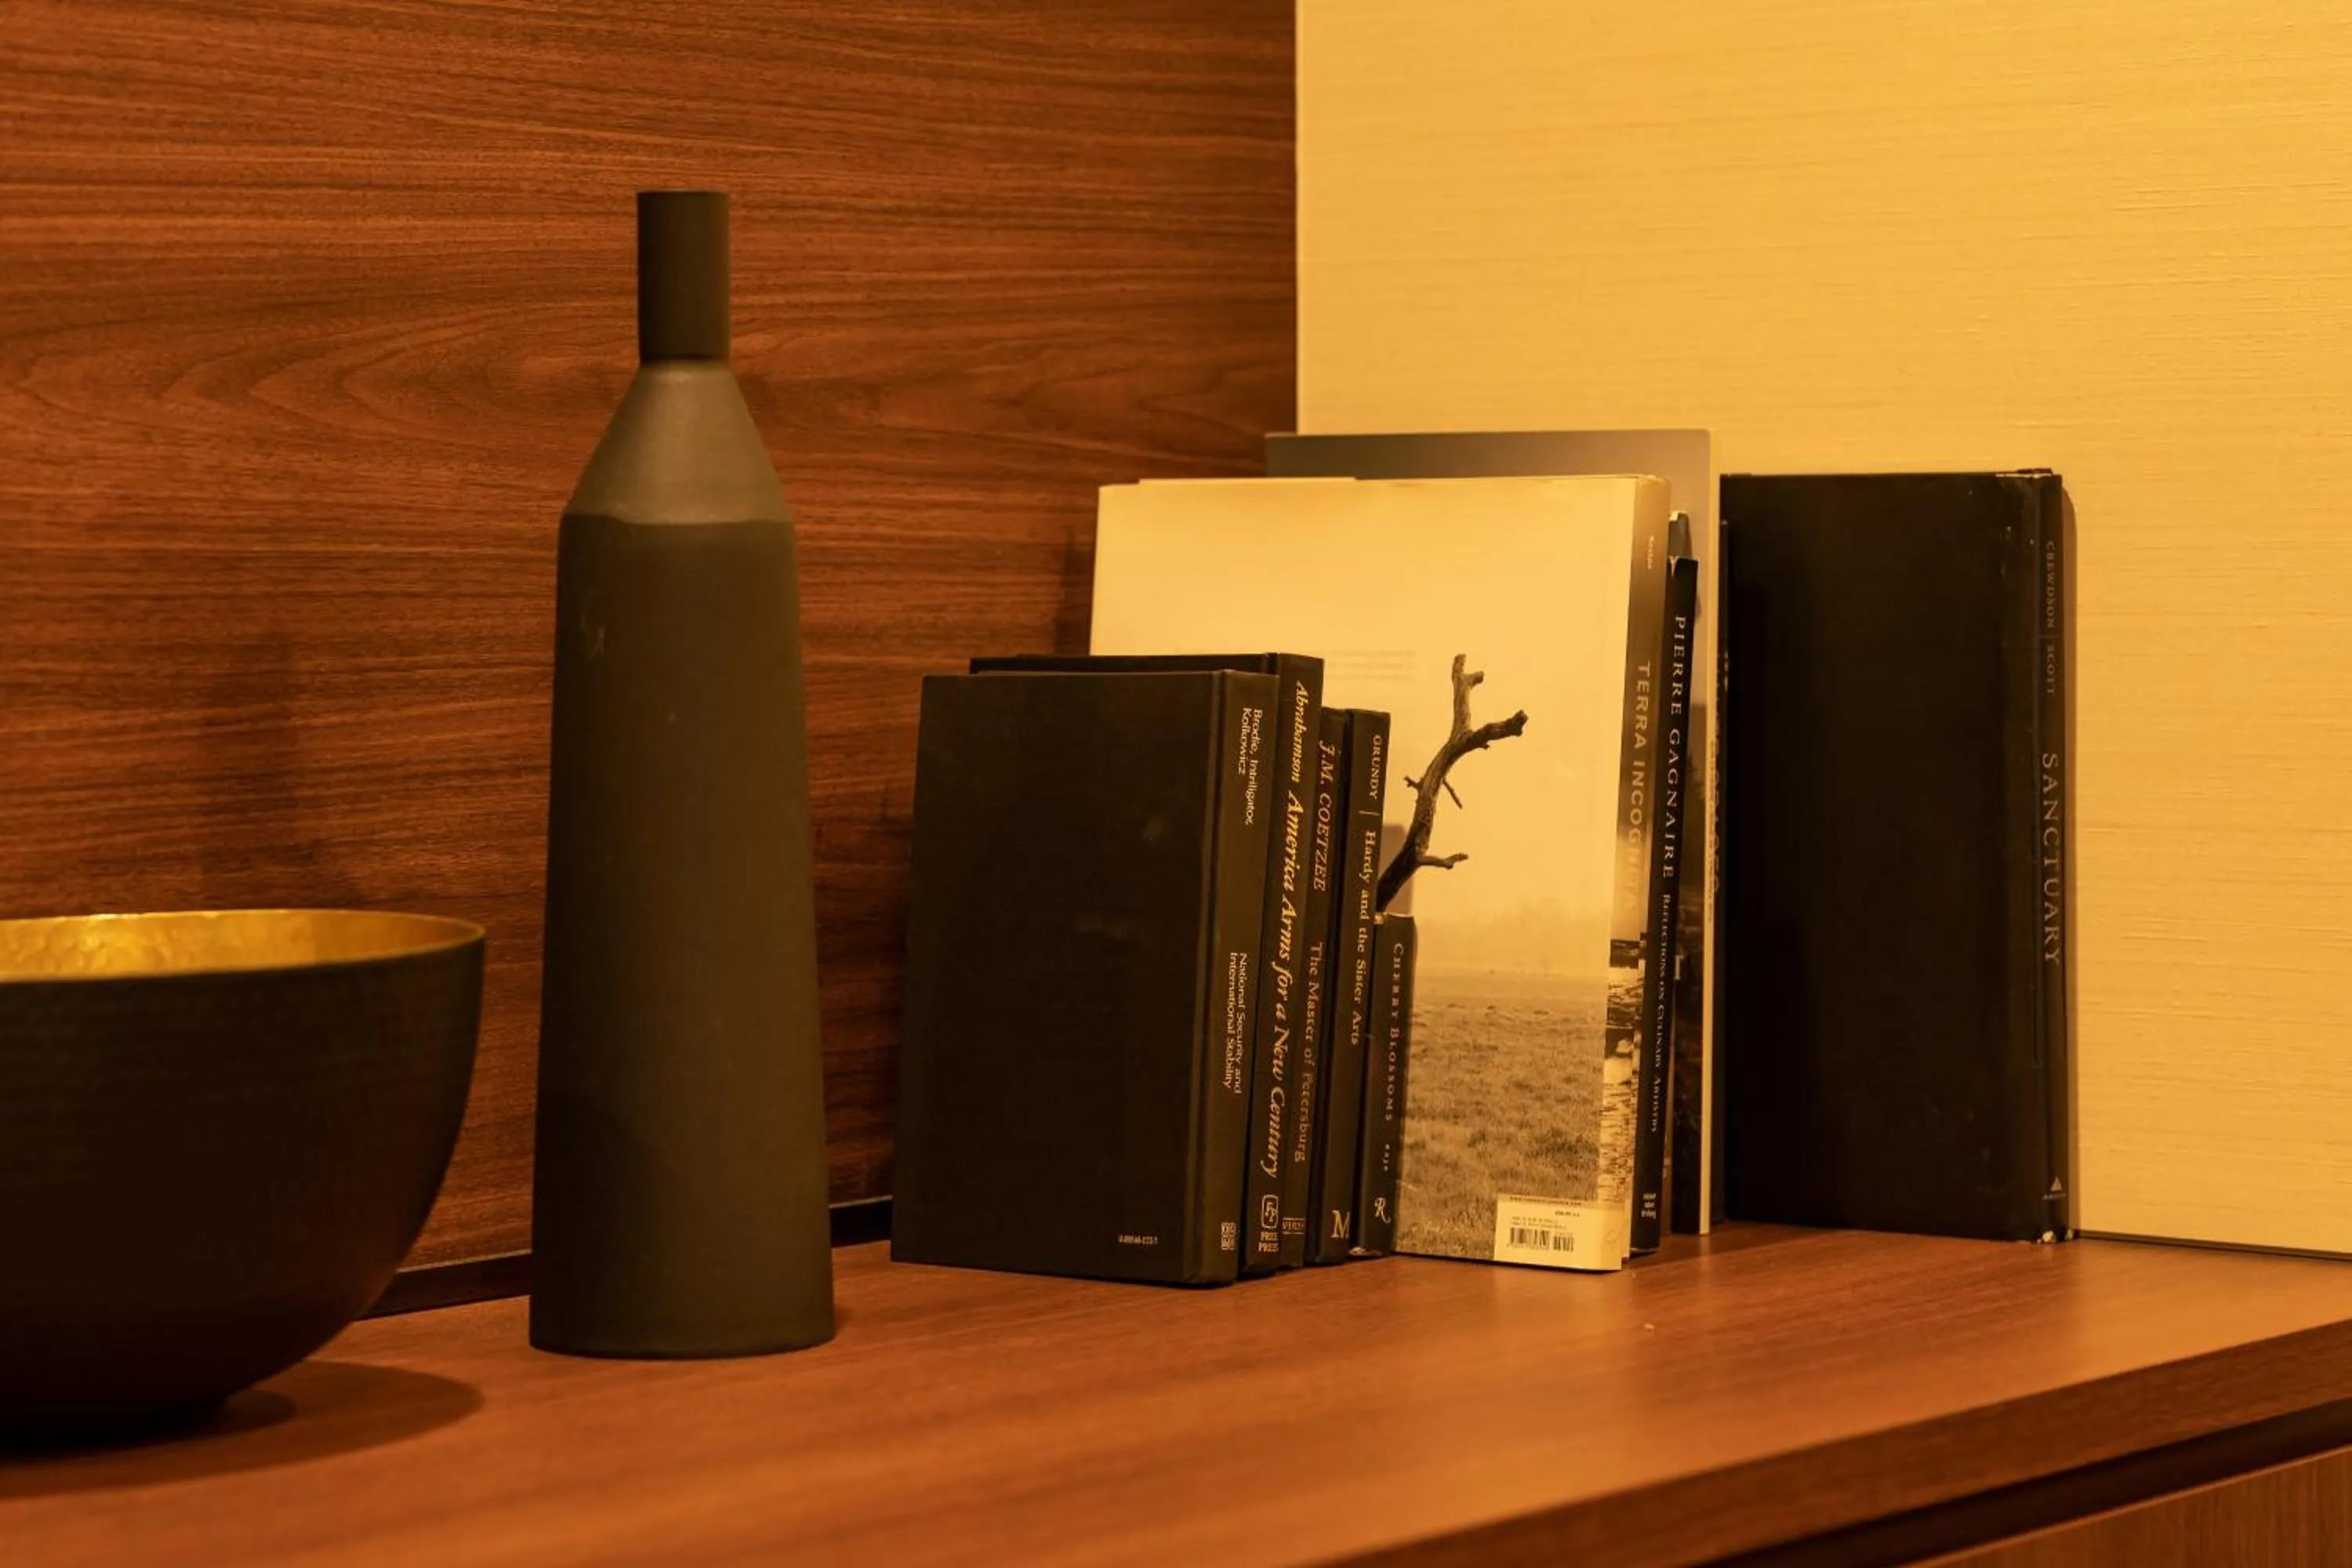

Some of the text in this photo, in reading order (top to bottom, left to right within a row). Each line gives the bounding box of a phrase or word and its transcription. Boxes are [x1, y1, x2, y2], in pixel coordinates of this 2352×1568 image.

[1634, 660, 1651, 750] TERRA
[1671, 615, 1686, 715] PIERRE
[2046, 644, 2056, 696] SCOTT
[1283, 790, 1304, 891] America
[1663, 728, 1680, 878] GAGNAIRE
[1351, 735, 1381, 1045] GRUNDY Hardy and the Sister Arts
[2042, 753, 2060, 965] SANCTUARY
[1279, 895, 1298, 960] Arms
[1294, 739, 1335, 1163] J.M. COETZEE The Master of Petersburg
[1222, 952, 1238, 1089] International Stability
[1232, 953, 1247, 1094] National Security and
[1271, 960, 1293, 1001] for
[1276, 1004, 1287, 1021] a
[1272, 1025, 1290, 1081] New
[1260, 1086, 1285, 1178] Century
[1330, 1210, 1350, 1239] M
